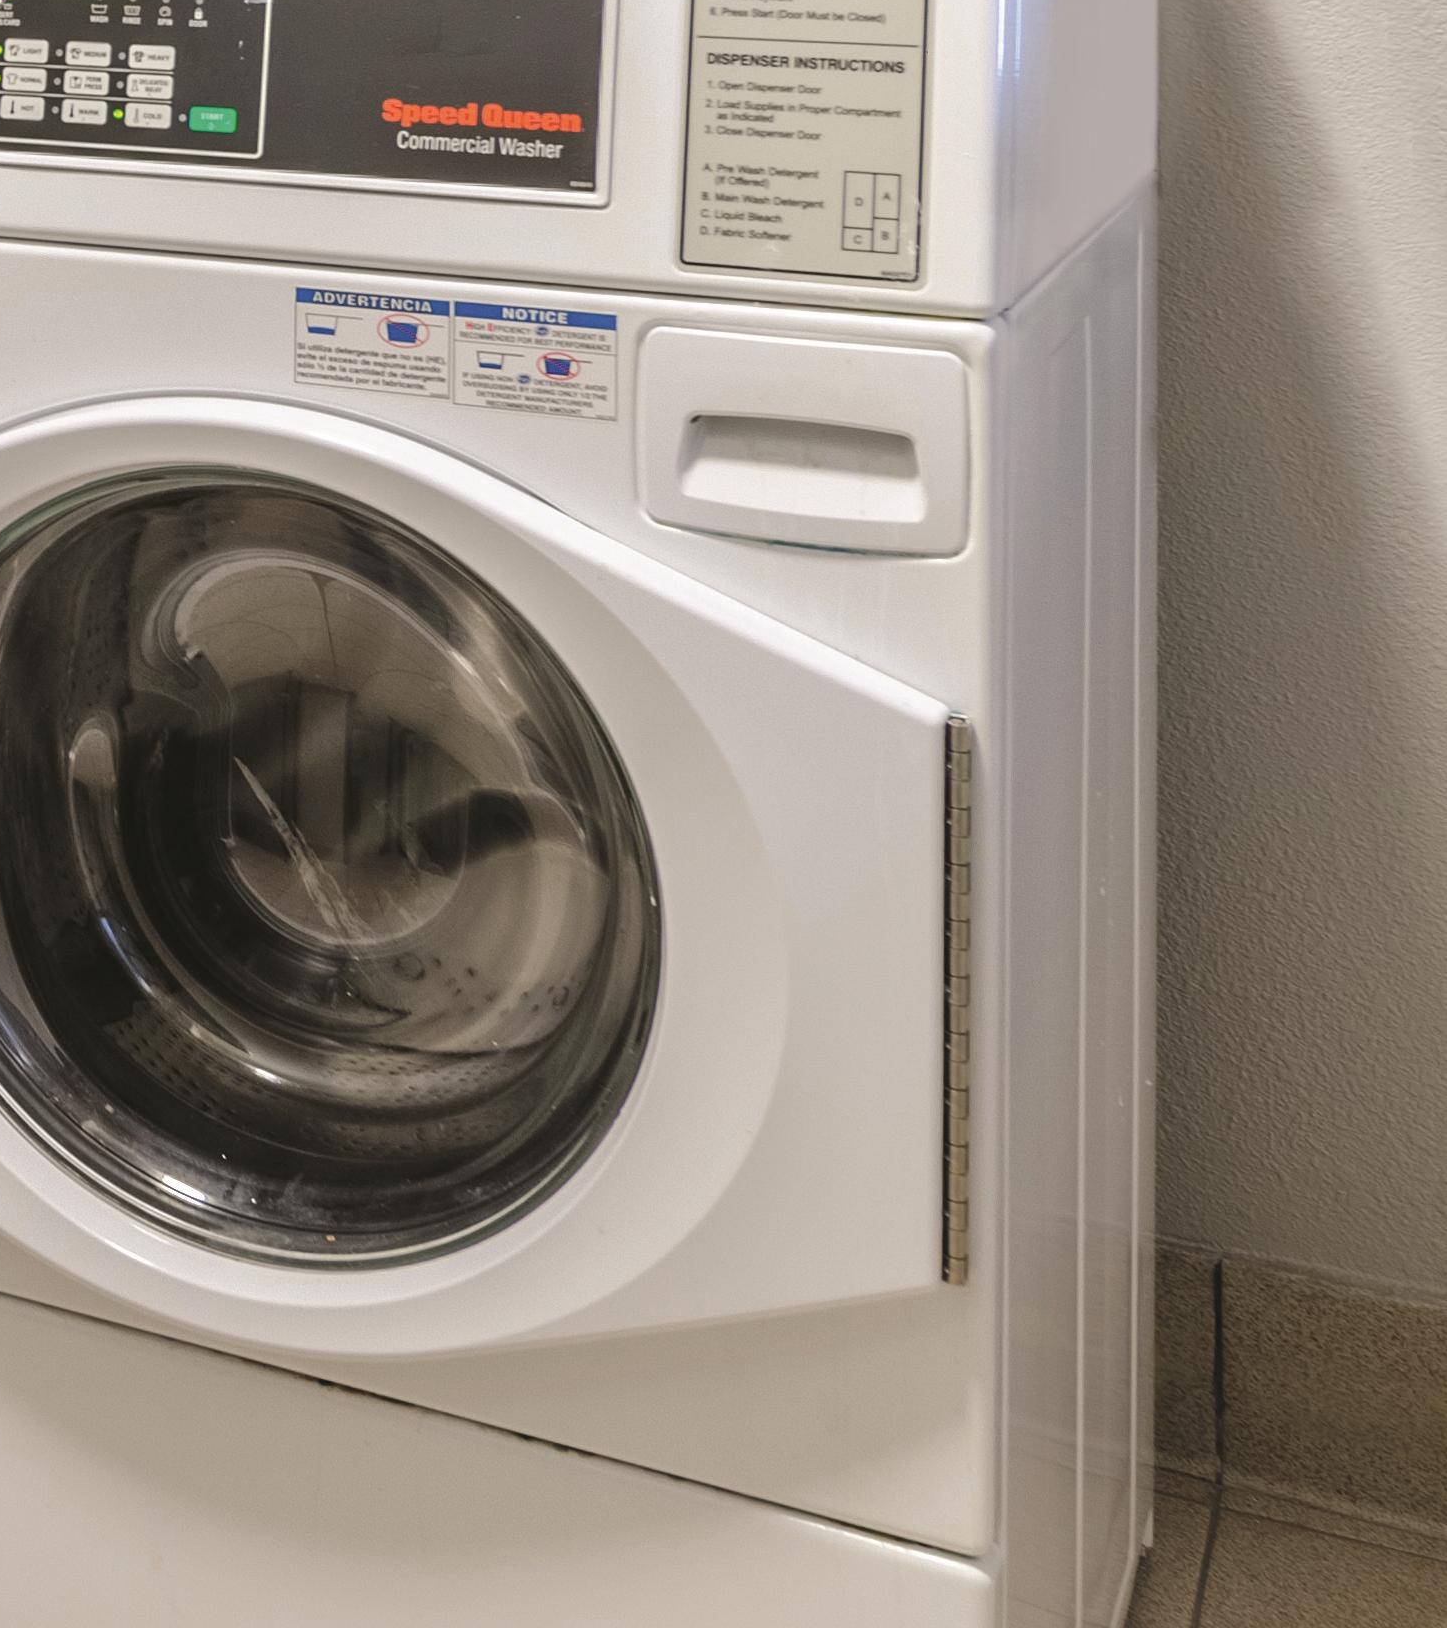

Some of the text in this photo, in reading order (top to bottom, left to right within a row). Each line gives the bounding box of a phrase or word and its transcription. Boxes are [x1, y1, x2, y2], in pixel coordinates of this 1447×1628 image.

[708, 53, 904, 73] DISPENSER INSTRUCTIONS
[382, 98, 582, 132] Speed Queen
[397, 130, 563, 158] Commercial Washer
[313, 292, 432, 313] ADVERTENCIA
[502, 308, 568, 324] NOTICE
